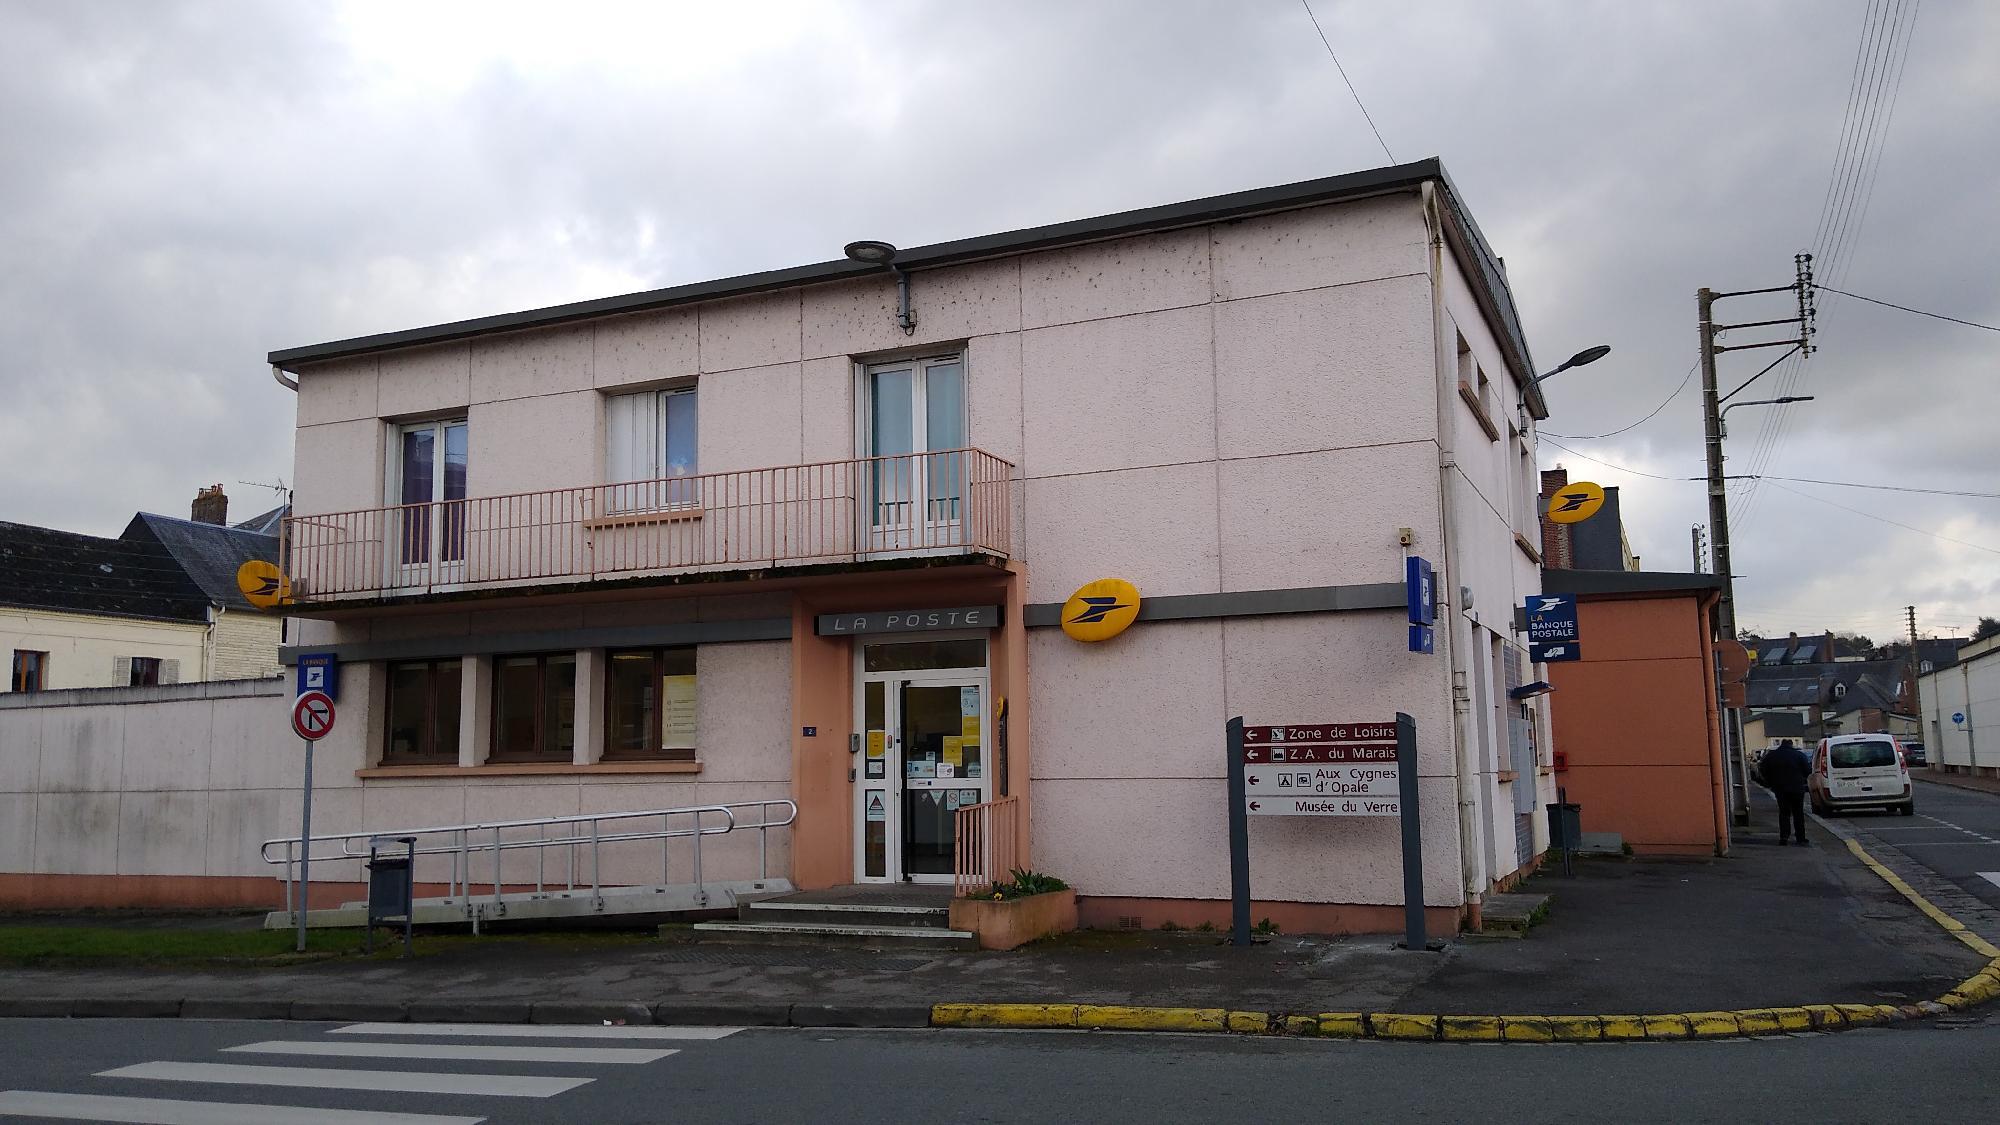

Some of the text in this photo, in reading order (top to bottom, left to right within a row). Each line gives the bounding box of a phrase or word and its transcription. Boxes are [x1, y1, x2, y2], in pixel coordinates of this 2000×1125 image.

[834, 611, 980, 631] LA POSTE
[1531, 621, 1573, 629] BANQUE
[1532, 629, 1574, 638] POSTALE
[1289, 725, 1395, 740] Zone de Loisirs
[1289, 746, 1396, 760] Z.A. du Marais
[1315, 767, 1397, 782] Aux Cygnes
[1315, 780, 1369, 795] d'Opale
[1295, 800, 1398, 813] Musée du Verre
